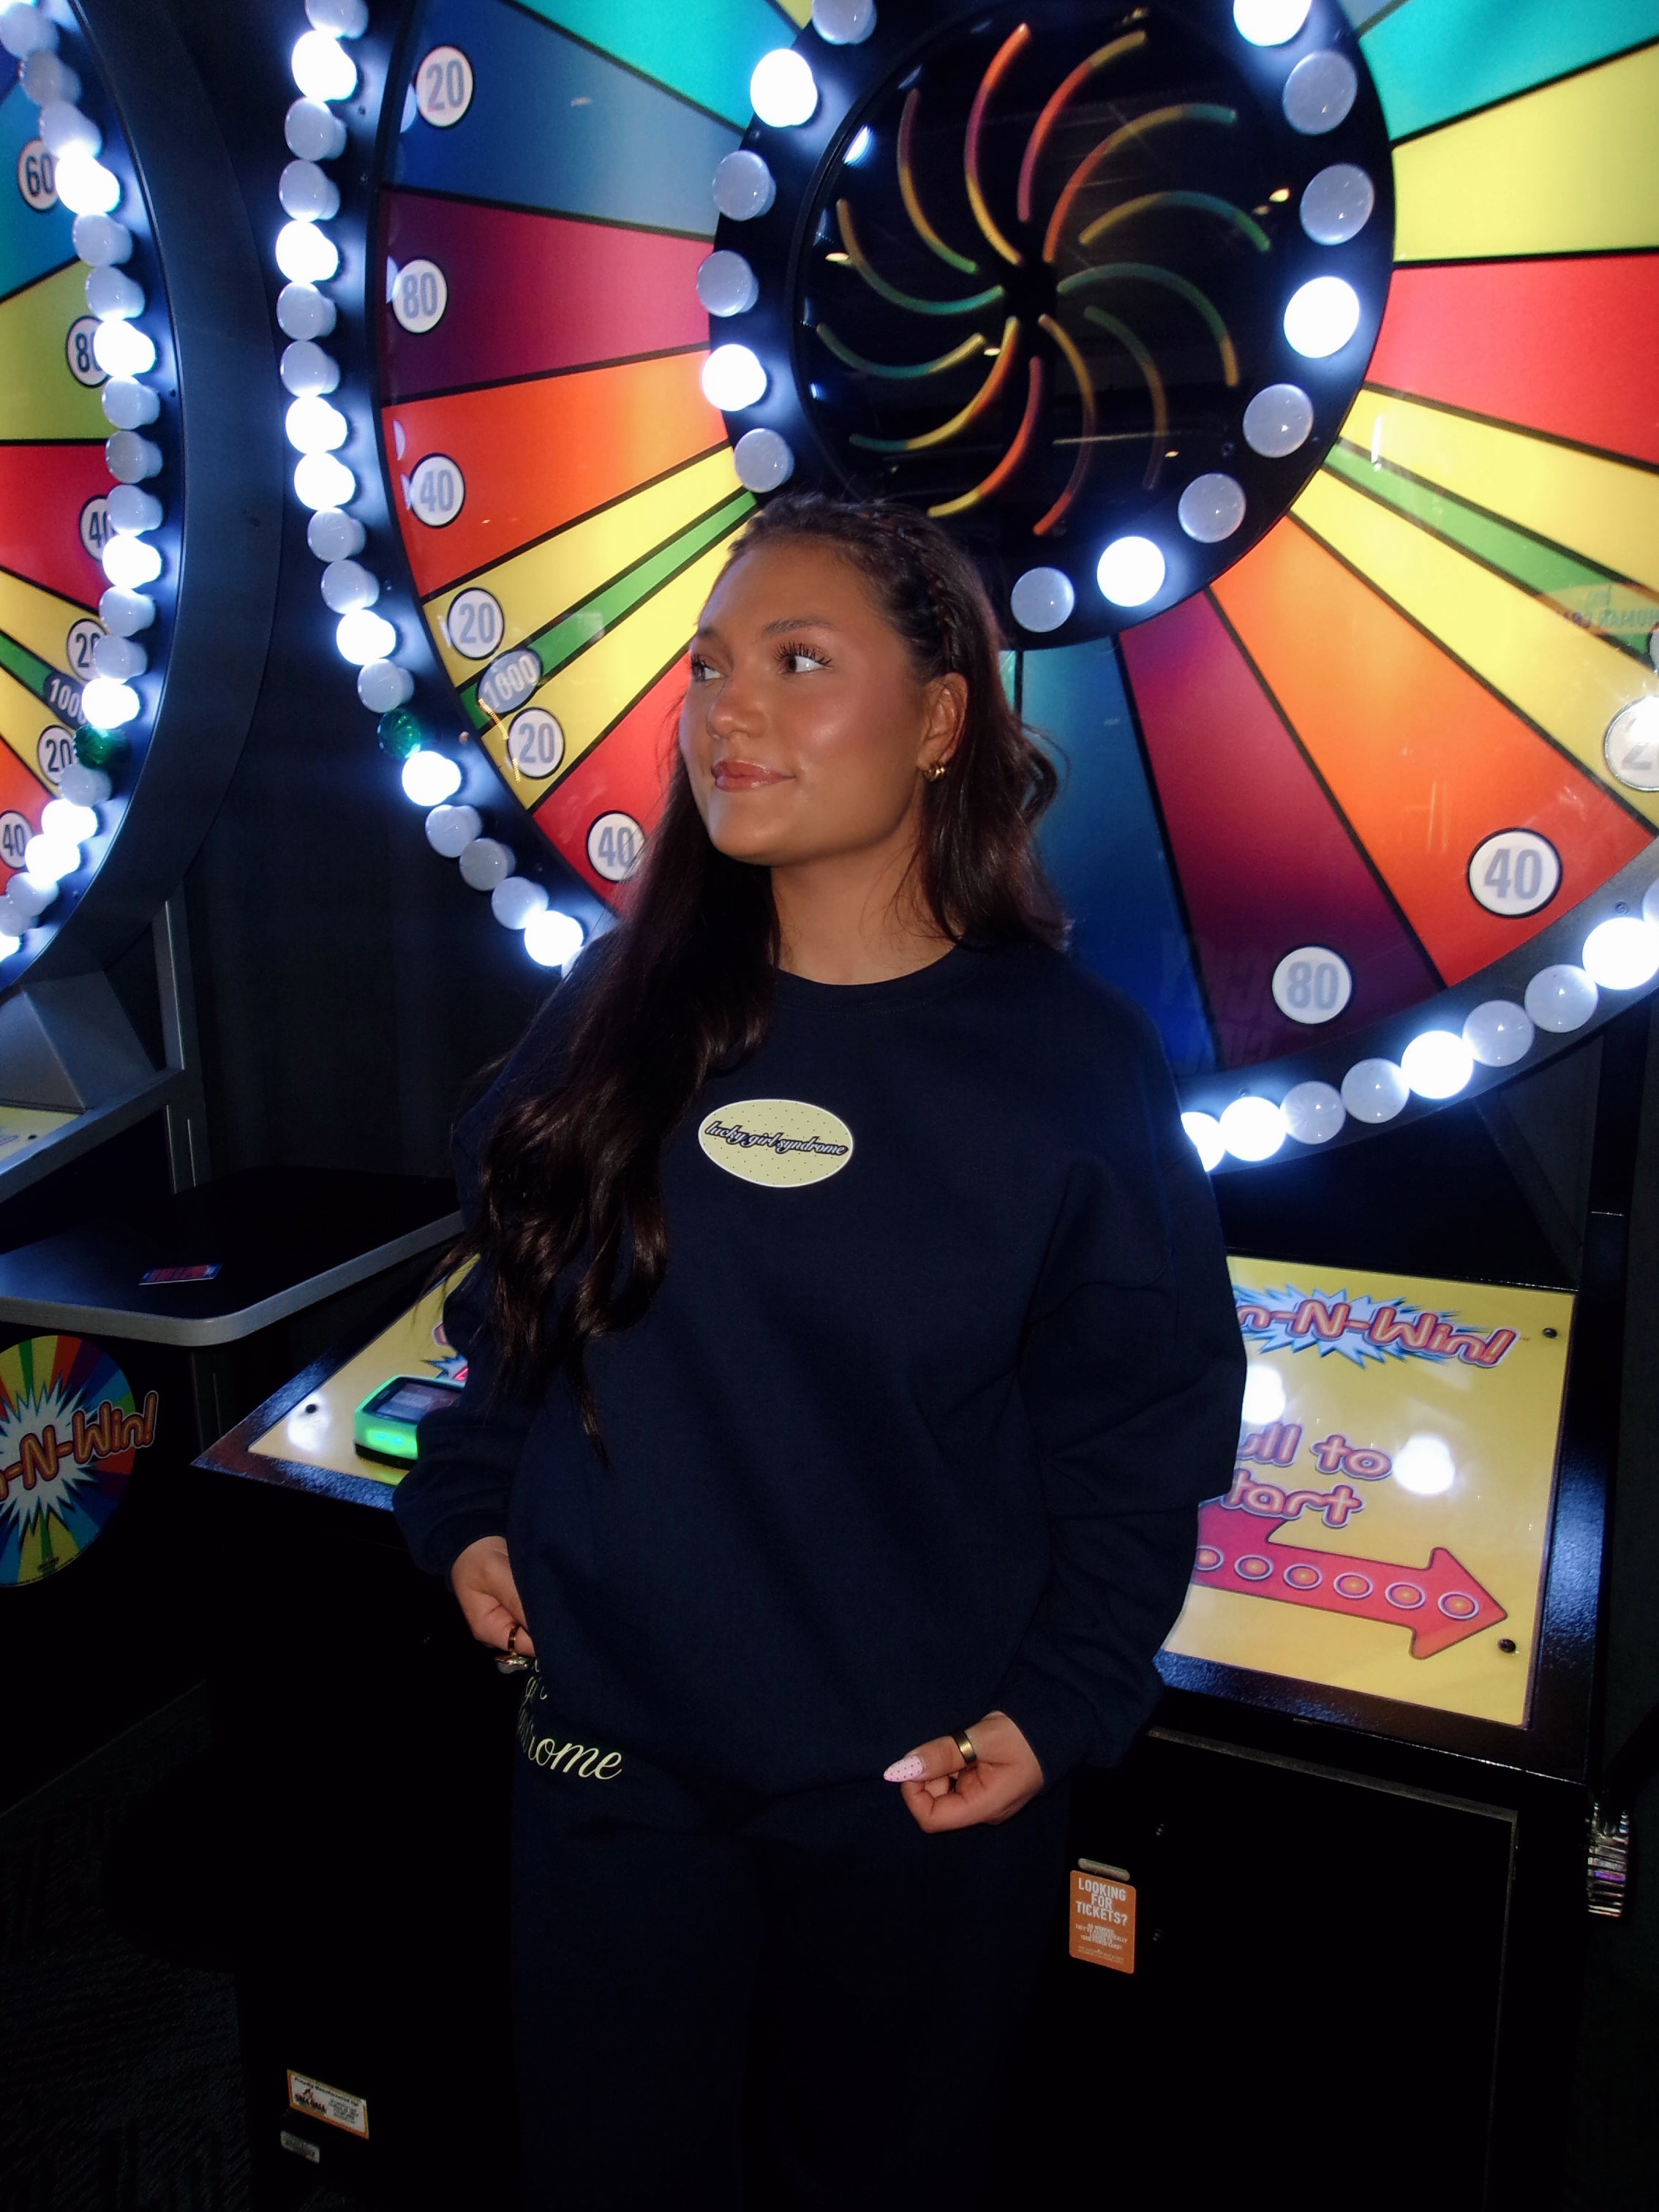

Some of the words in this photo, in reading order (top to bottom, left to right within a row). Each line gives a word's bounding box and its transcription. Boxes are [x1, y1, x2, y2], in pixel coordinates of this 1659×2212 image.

[426, 59, 465, 111] 20
[26, 155, 53, 197] 60
[402, 271, 438, 319] 80
[75, 332, 102, 372] 8
[420, 470, 454, 512] 40
[459, 602, 495, 645] 20
[484, 655, 538, 707] 1000
[518, 722, 554, 764] 20
[3, 824, 25, 857] 40
[598, 826, 636, 868] 40
[1483, 849, 1543, 900] 40
[1285, 961, 1339, 1010] 80
[705, 1121, 748, 1145] lucky
[740, 1132, 784, 1148] girl
[775, 1136, 849, 1156] syndrome
[1311, 1434, 1393, 1480] to
[1221, 1467, 1366, 1528] tart
[1078, 1878, 1126, 1901] LOOKING
[1091, 1892, 1113, 1911] FOR
[1076, 1901, 1128, 1925] TICKETS?
